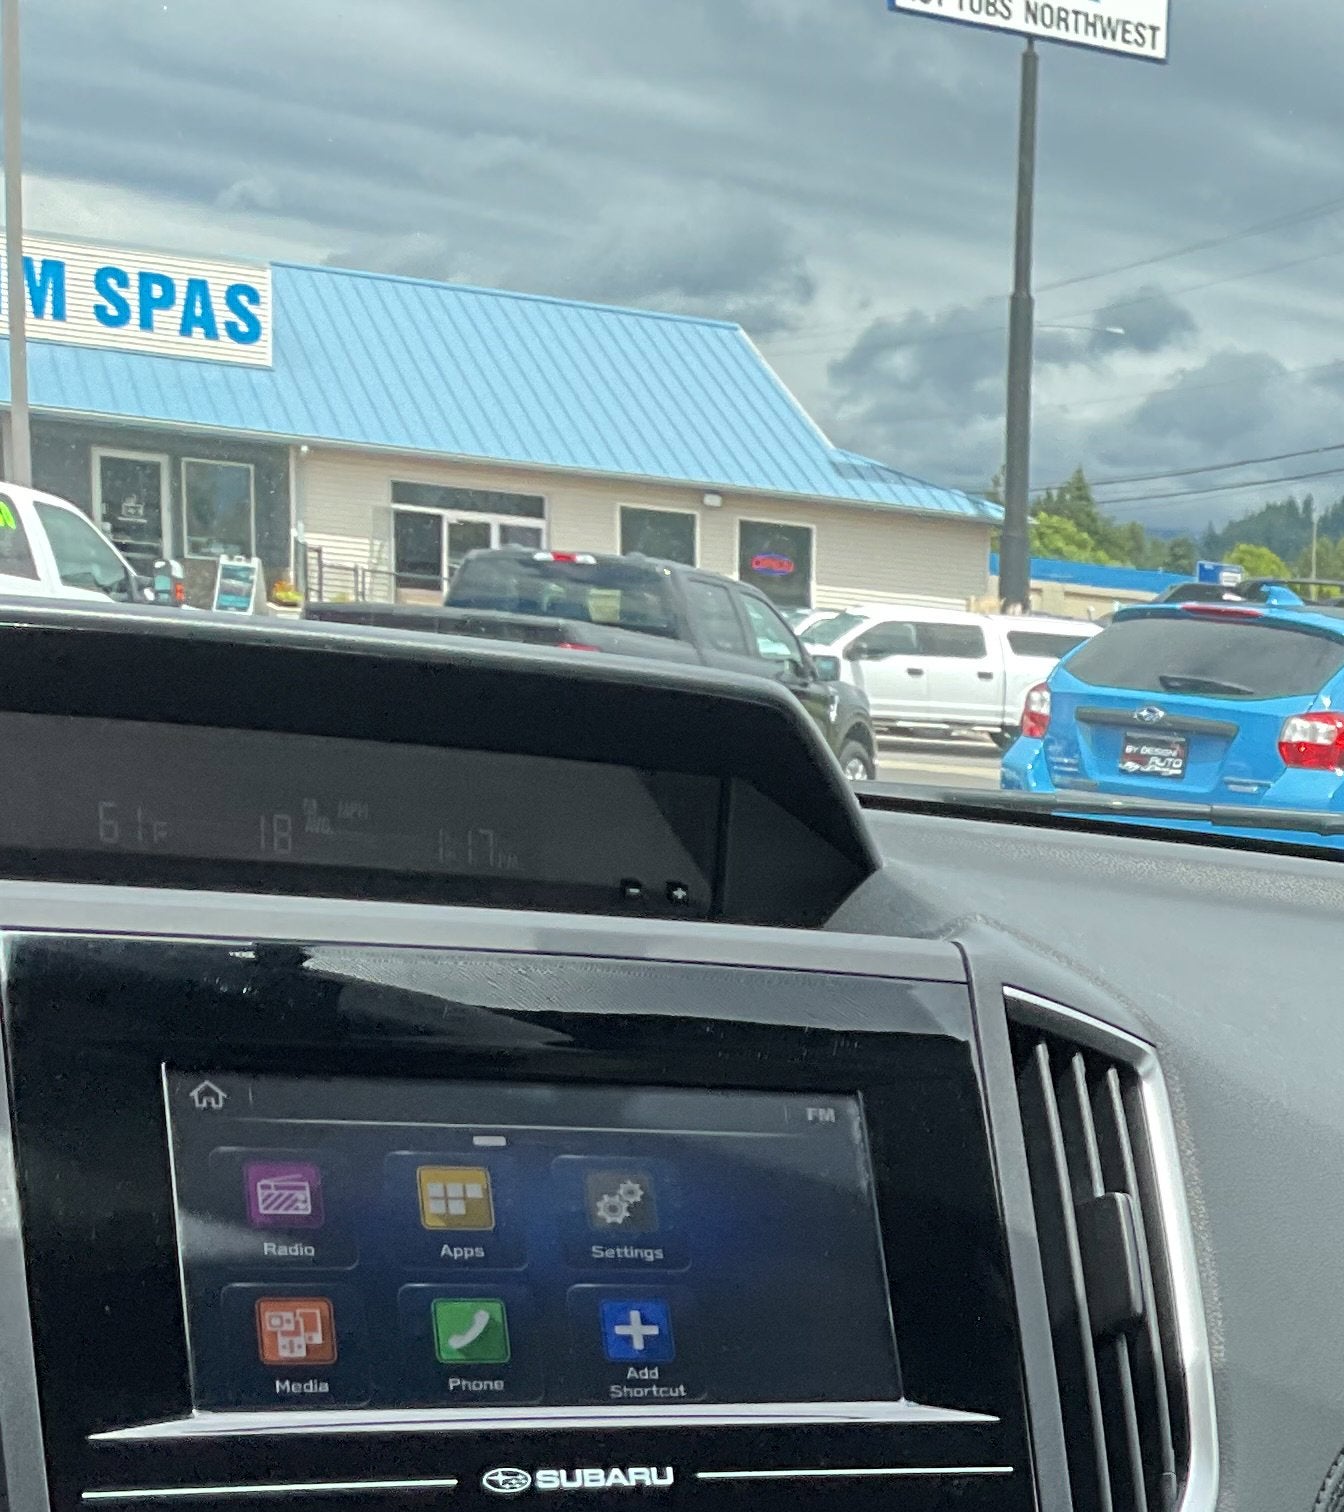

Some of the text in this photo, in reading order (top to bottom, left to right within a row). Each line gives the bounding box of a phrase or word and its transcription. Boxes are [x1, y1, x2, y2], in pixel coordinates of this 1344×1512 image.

[1024, 0, 1161, 50] NORTHWEST
[22, 255, 263, 345] M SPAS
[1148, 756, 1183, 768] AUTO
[806, 1107, 836, 1122] FM
[263, 1242, 316, 1257] Radio
[440, 1243, 486, 1260] Apps
[590, 1245, 665, 1261] Settings
[626, 1366, 660, 1381] Add
[275, 1378, 330, 1394] Media
[448, 1377, 505, 1392] Phone
[609, 1382, 688, 1399] Shortcut
[535, 1466, 675, 1490] SUBARU
